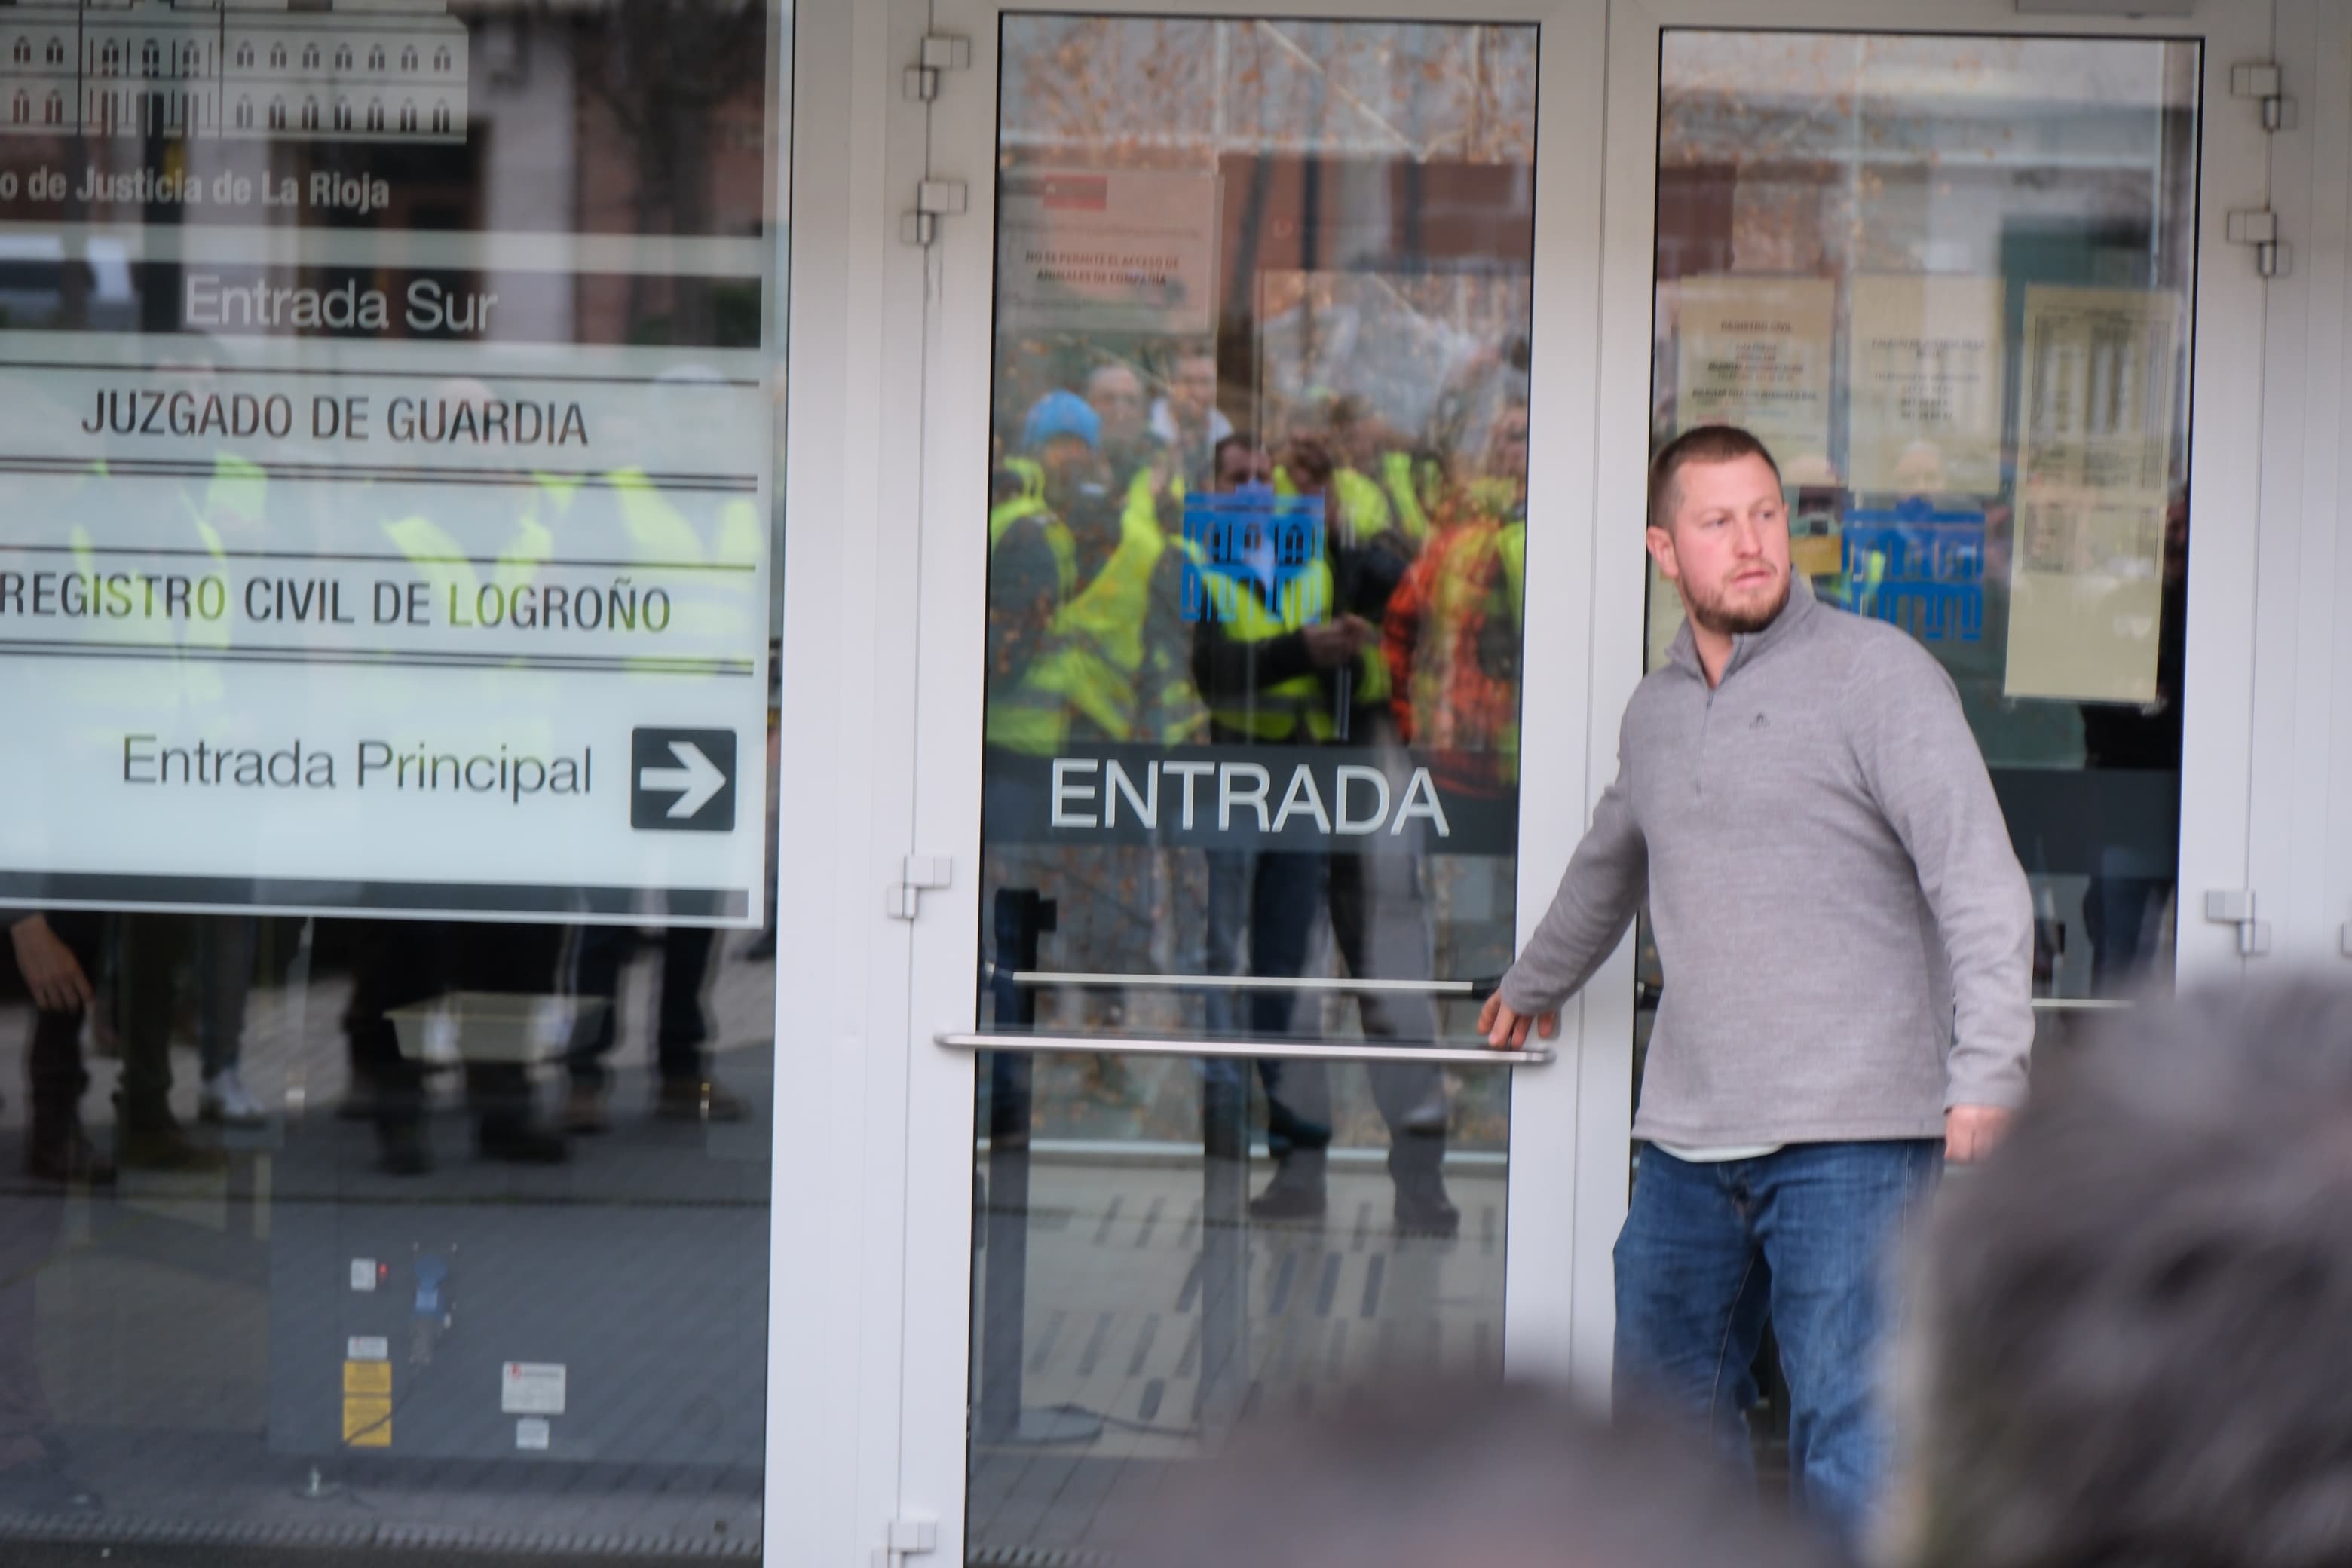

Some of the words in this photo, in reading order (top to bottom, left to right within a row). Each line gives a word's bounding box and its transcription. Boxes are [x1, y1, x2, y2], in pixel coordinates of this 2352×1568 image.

[28, 165, 66, 201] de
[75, 166, 202, 204] Justicia
[213, 168, 251, 204] de
[262, 169, 299, 207] La
[310, 171, 389, 214] Rioja
[1026, 251, 1043, 263] NO
[1059, 253, 1105, 265] PERMITE
[1037, 269, 1091, 283] ANIMALES
[185, 274, 389, 330] Entrada
[405, 279, 498, 332] Sur
[81, 390, 293, 438] JUZGADO
[311, 395, 369, 439] DE
[388, 399, 589, 446] GUARDIA
[0, 571, 226, 621] REGISTRO
[243, 577, 354, 624] CIVIL
[373, 581, 430, 626] DE
[450, 577, 672, 632] LOGROÑO
[123, 734, 335, 789] Entrada
[357, 739, 593, 804] Principal
[1051, 758, 1450, 837] ENTRADA
